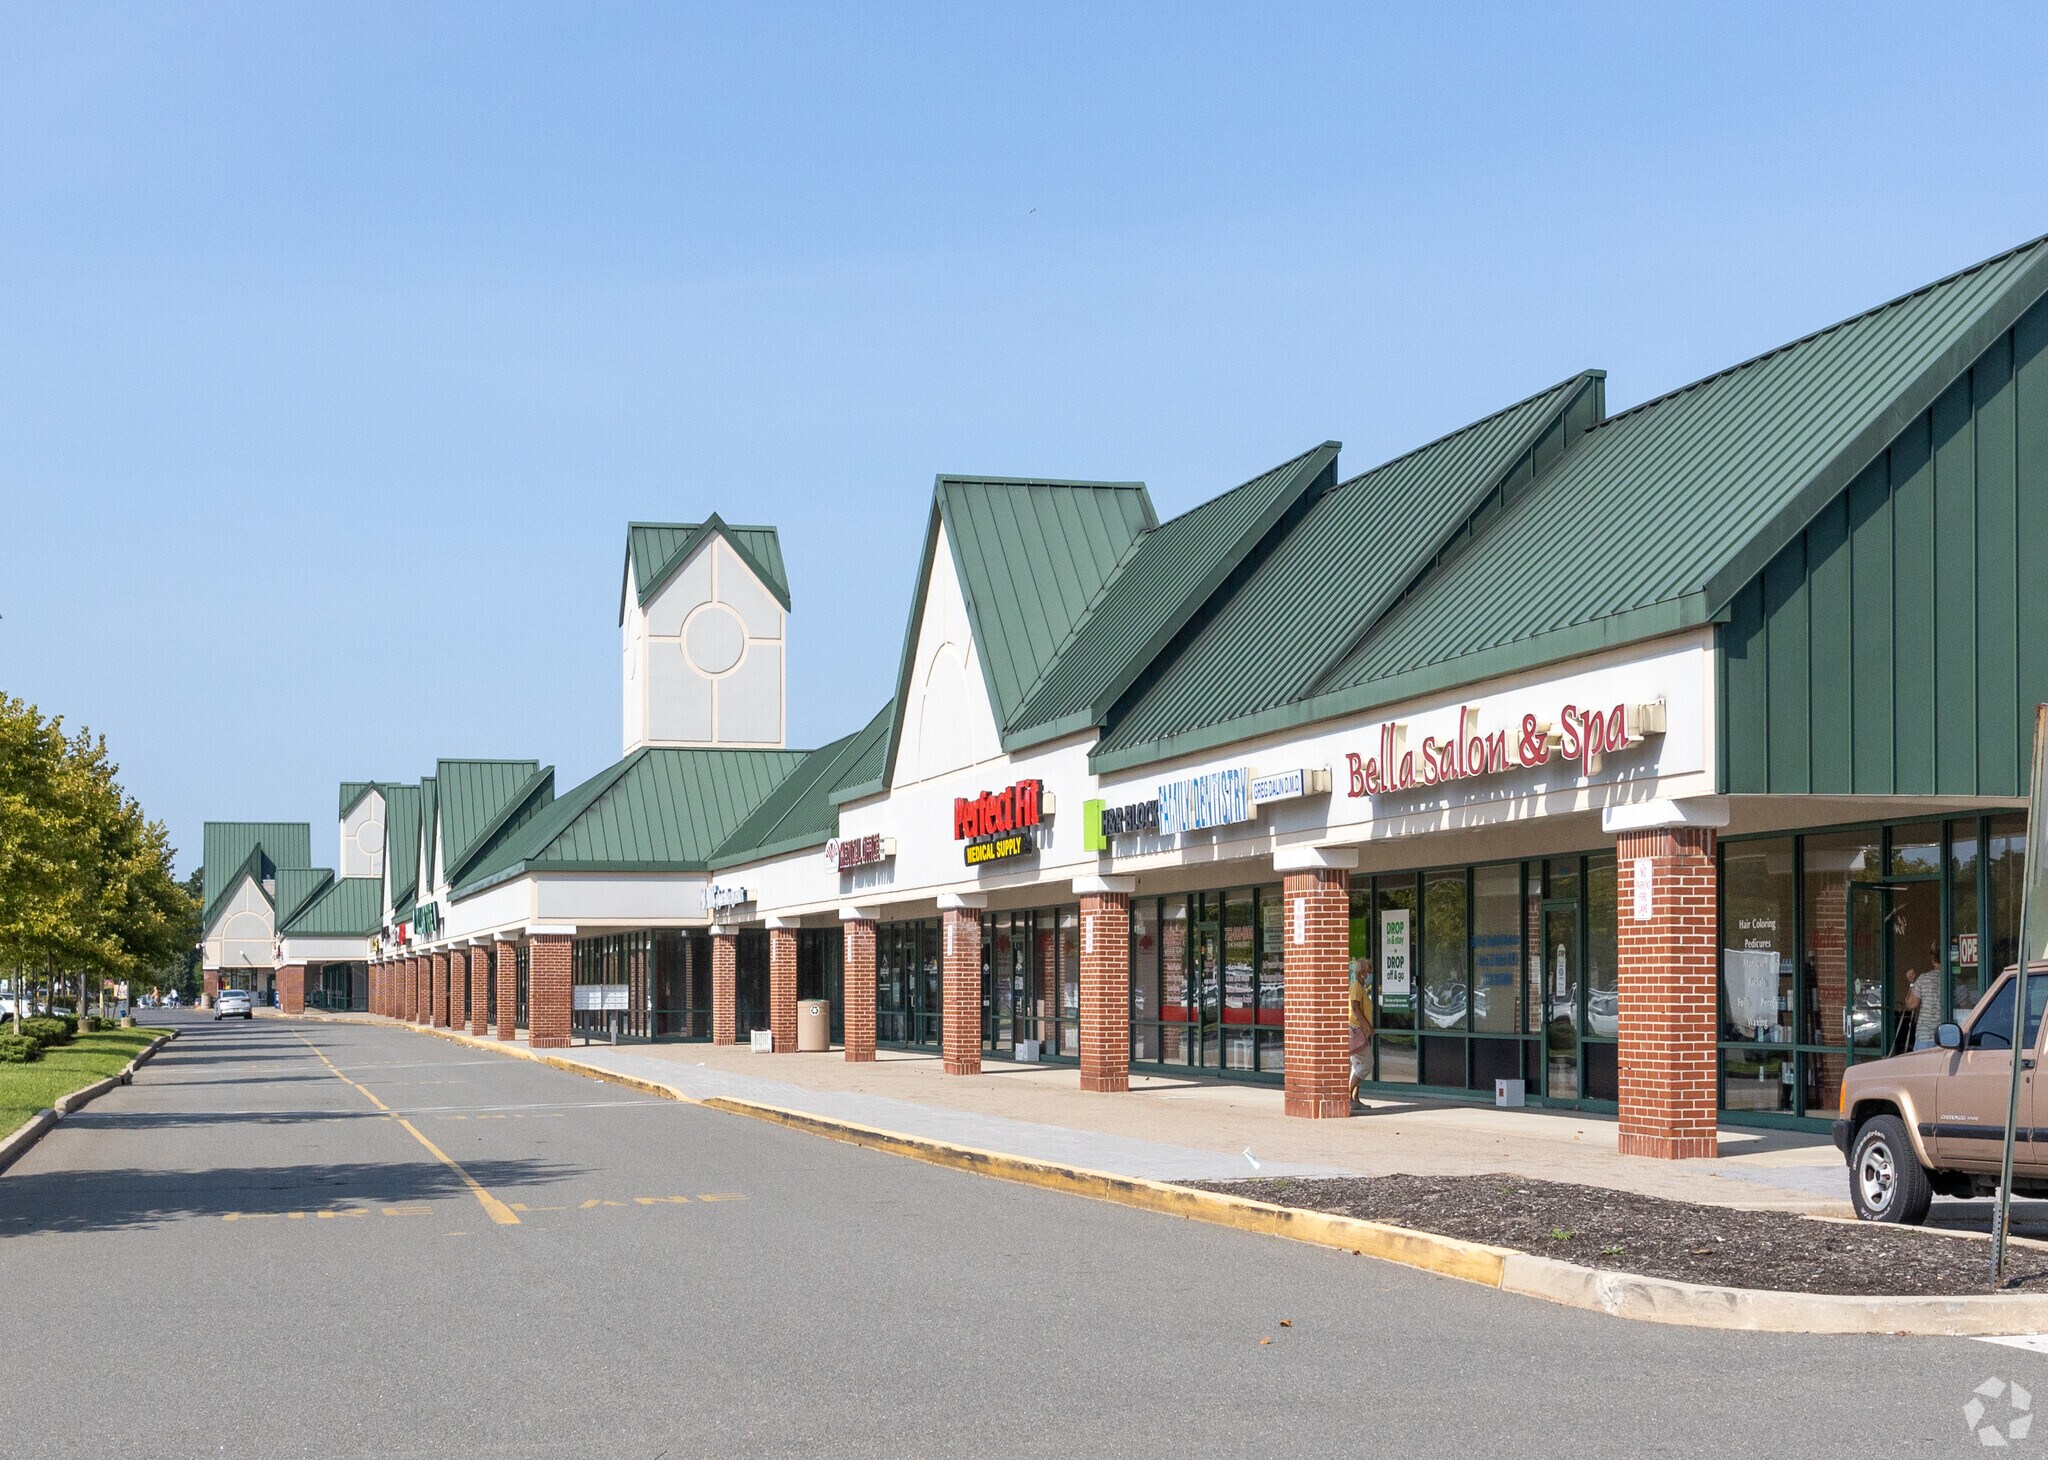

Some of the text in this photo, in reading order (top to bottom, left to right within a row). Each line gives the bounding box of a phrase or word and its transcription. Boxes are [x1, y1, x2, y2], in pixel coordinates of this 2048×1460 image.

[1346, 703, 1629, 798] Bella Salon & Spa
[1158, 767, 1248, 836] FAMILY DENTISTRY
[1254, 781, 1268, 799] GREG
[954, 779, 1040, 840] Perfect Fit
[1101, 799, 1159, 836] H&R BLOCK
[967, 837, 1021, 863] MEDICAL SUPPLY
[1387, 921, 1404, 934] DROP
[1738, 918, 1776, 931] Hair Coloring
[1744, 938, 1771, 949] Pedicures
[1961, 938, 1978, 963] OPE
[1387, 956, 1404, 968] DROP
